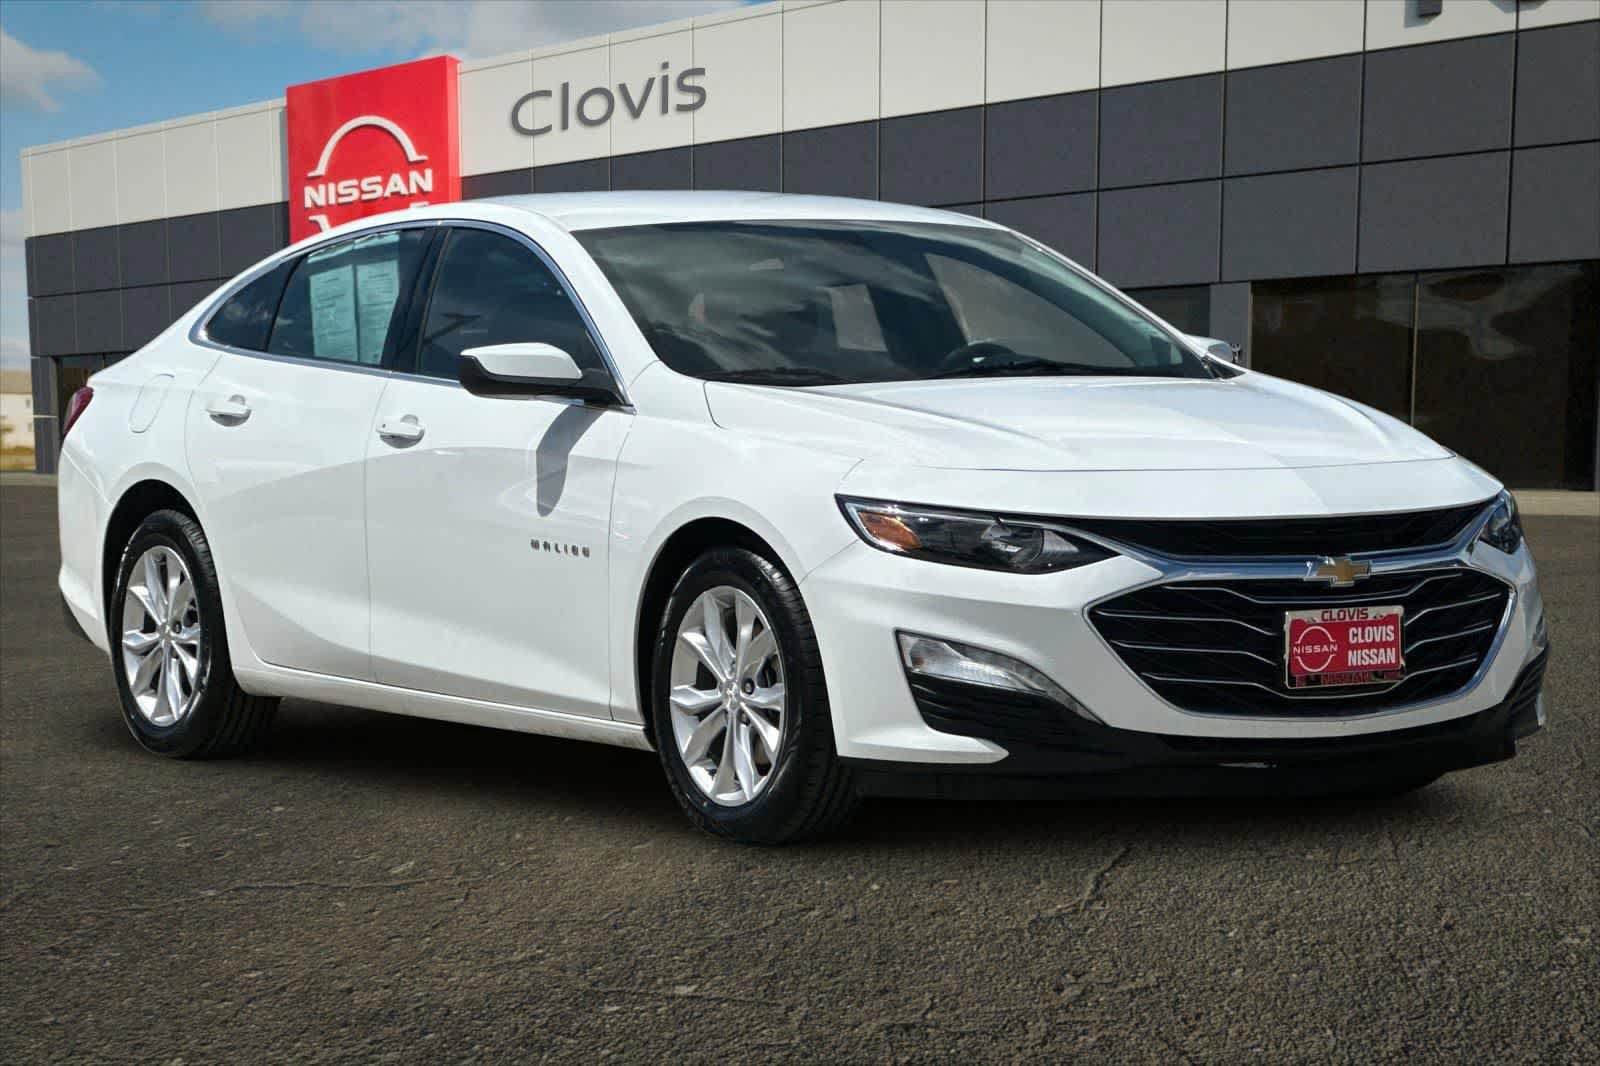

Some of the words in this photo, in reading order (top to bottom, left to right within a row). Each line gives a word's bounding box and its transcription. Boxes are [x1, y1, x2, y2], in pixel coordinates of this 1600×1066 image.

[511, 61, 706, 136] Clovis
[304, 168, 433, 208] NISSAN
[1321, 608, 1369, 622] CLOVIS
[1348, 625, 1395, 644] CLOVIS
[1293, 644, 1338, 655] NISSAN
[1347, 647, 1396, 667] NISSAN
